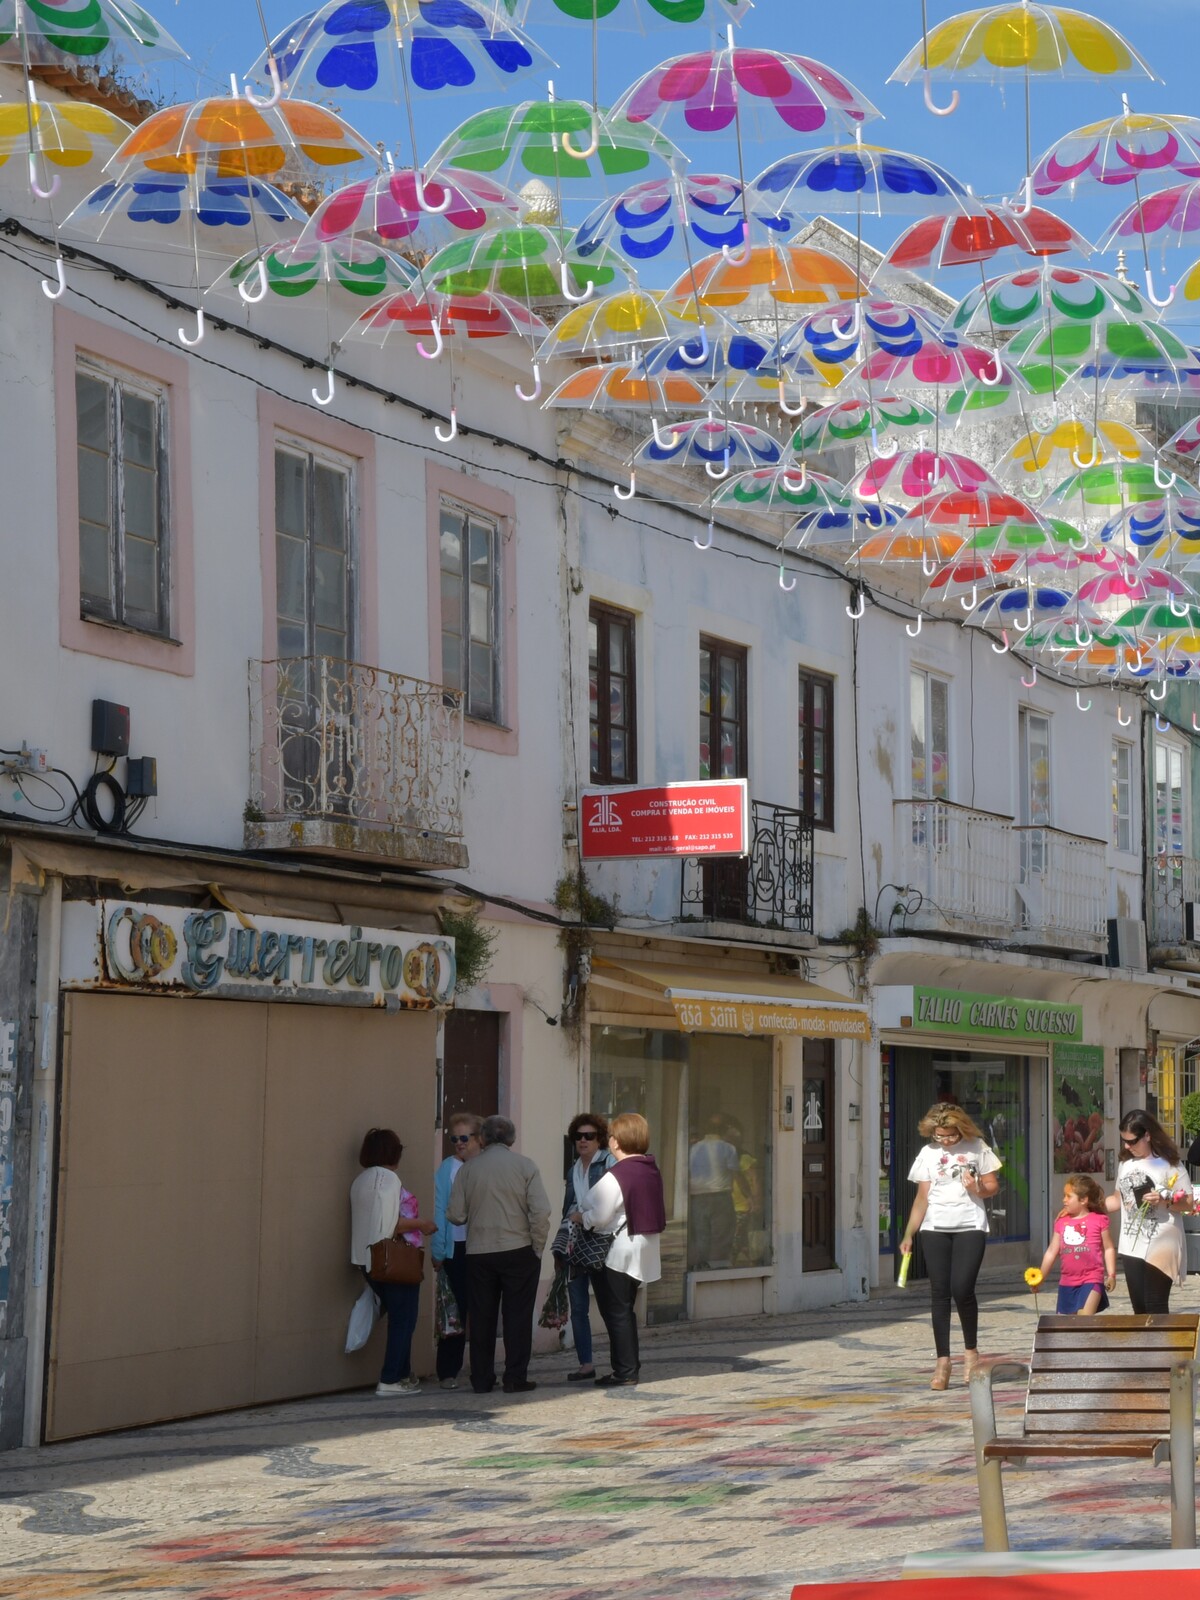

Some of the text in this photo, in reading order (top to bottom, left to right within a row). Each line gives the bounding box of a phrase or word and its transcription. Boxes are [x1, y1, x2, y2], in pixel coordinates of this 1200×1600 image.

[631, 805, 735, 817] COMPRA E VENDA DE IMÓVEIS
[649, 798, 717, 809] CONSTRUÇÃO CIVIL
[180, 909, 402, 991] Guerreiro
[709, 1006, 738, 1028] sam
[918, 995, 1078, 1035] TALHO CARNES SUCESSO
